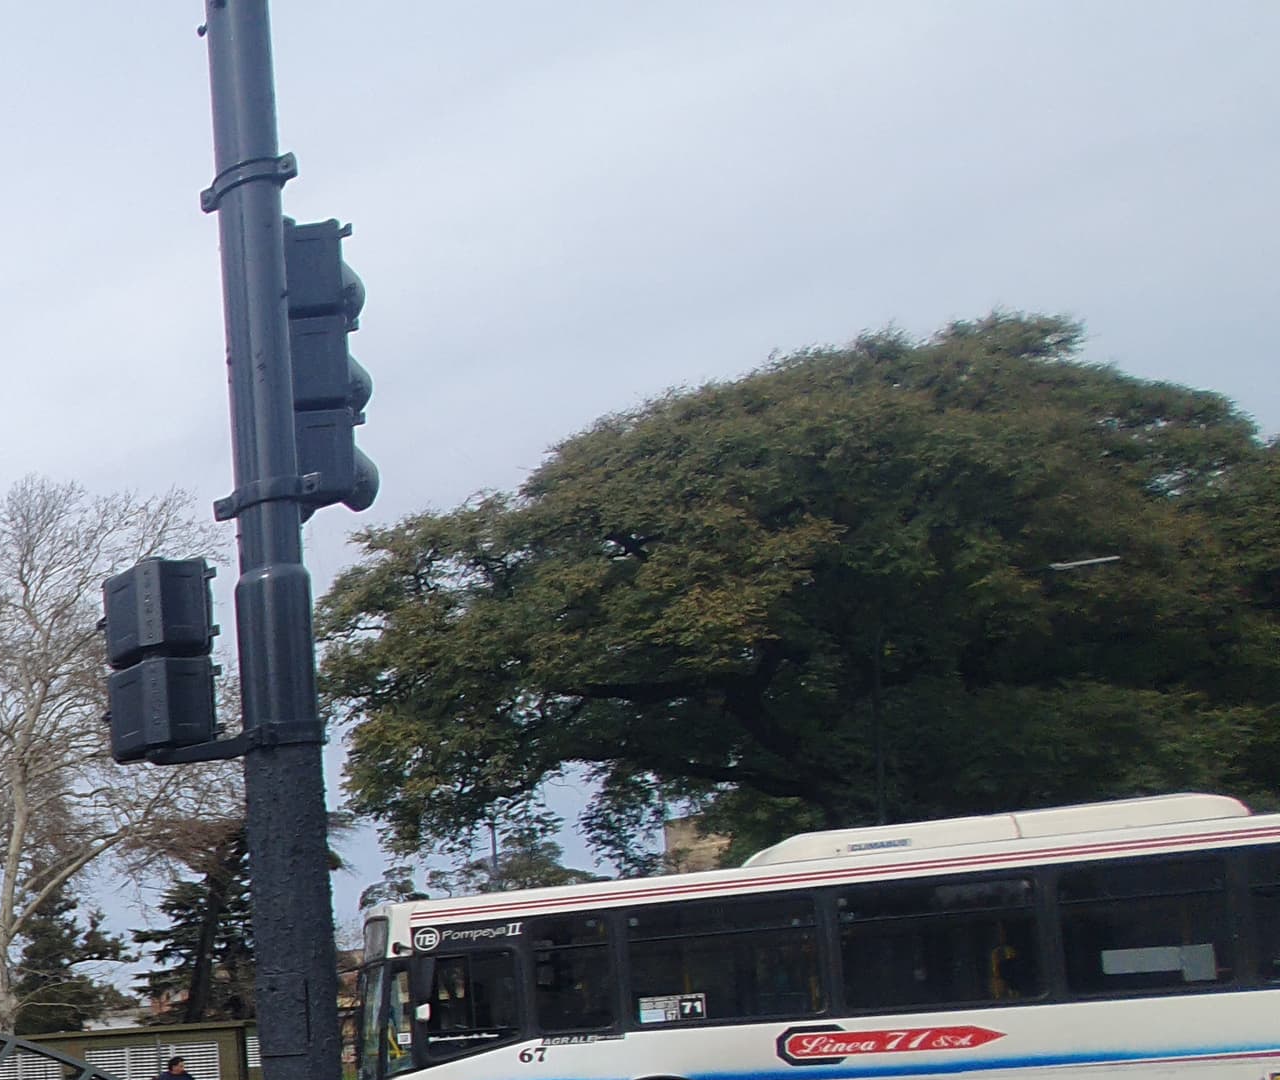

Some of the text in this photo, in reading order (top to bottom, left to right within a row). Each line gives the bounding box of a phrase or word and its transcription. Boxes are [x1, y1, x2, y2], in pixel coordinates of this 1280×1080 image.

[441, 921, 524, 942] Pompeya II
[415, 932, 437, 947] TB
[681, 1000, 703, 1014] 71
[543, 1034, 596, 1046] AGRALE
[886, 1030, 932, 1050] 71
[519, 1047, 548, 1063] 67
